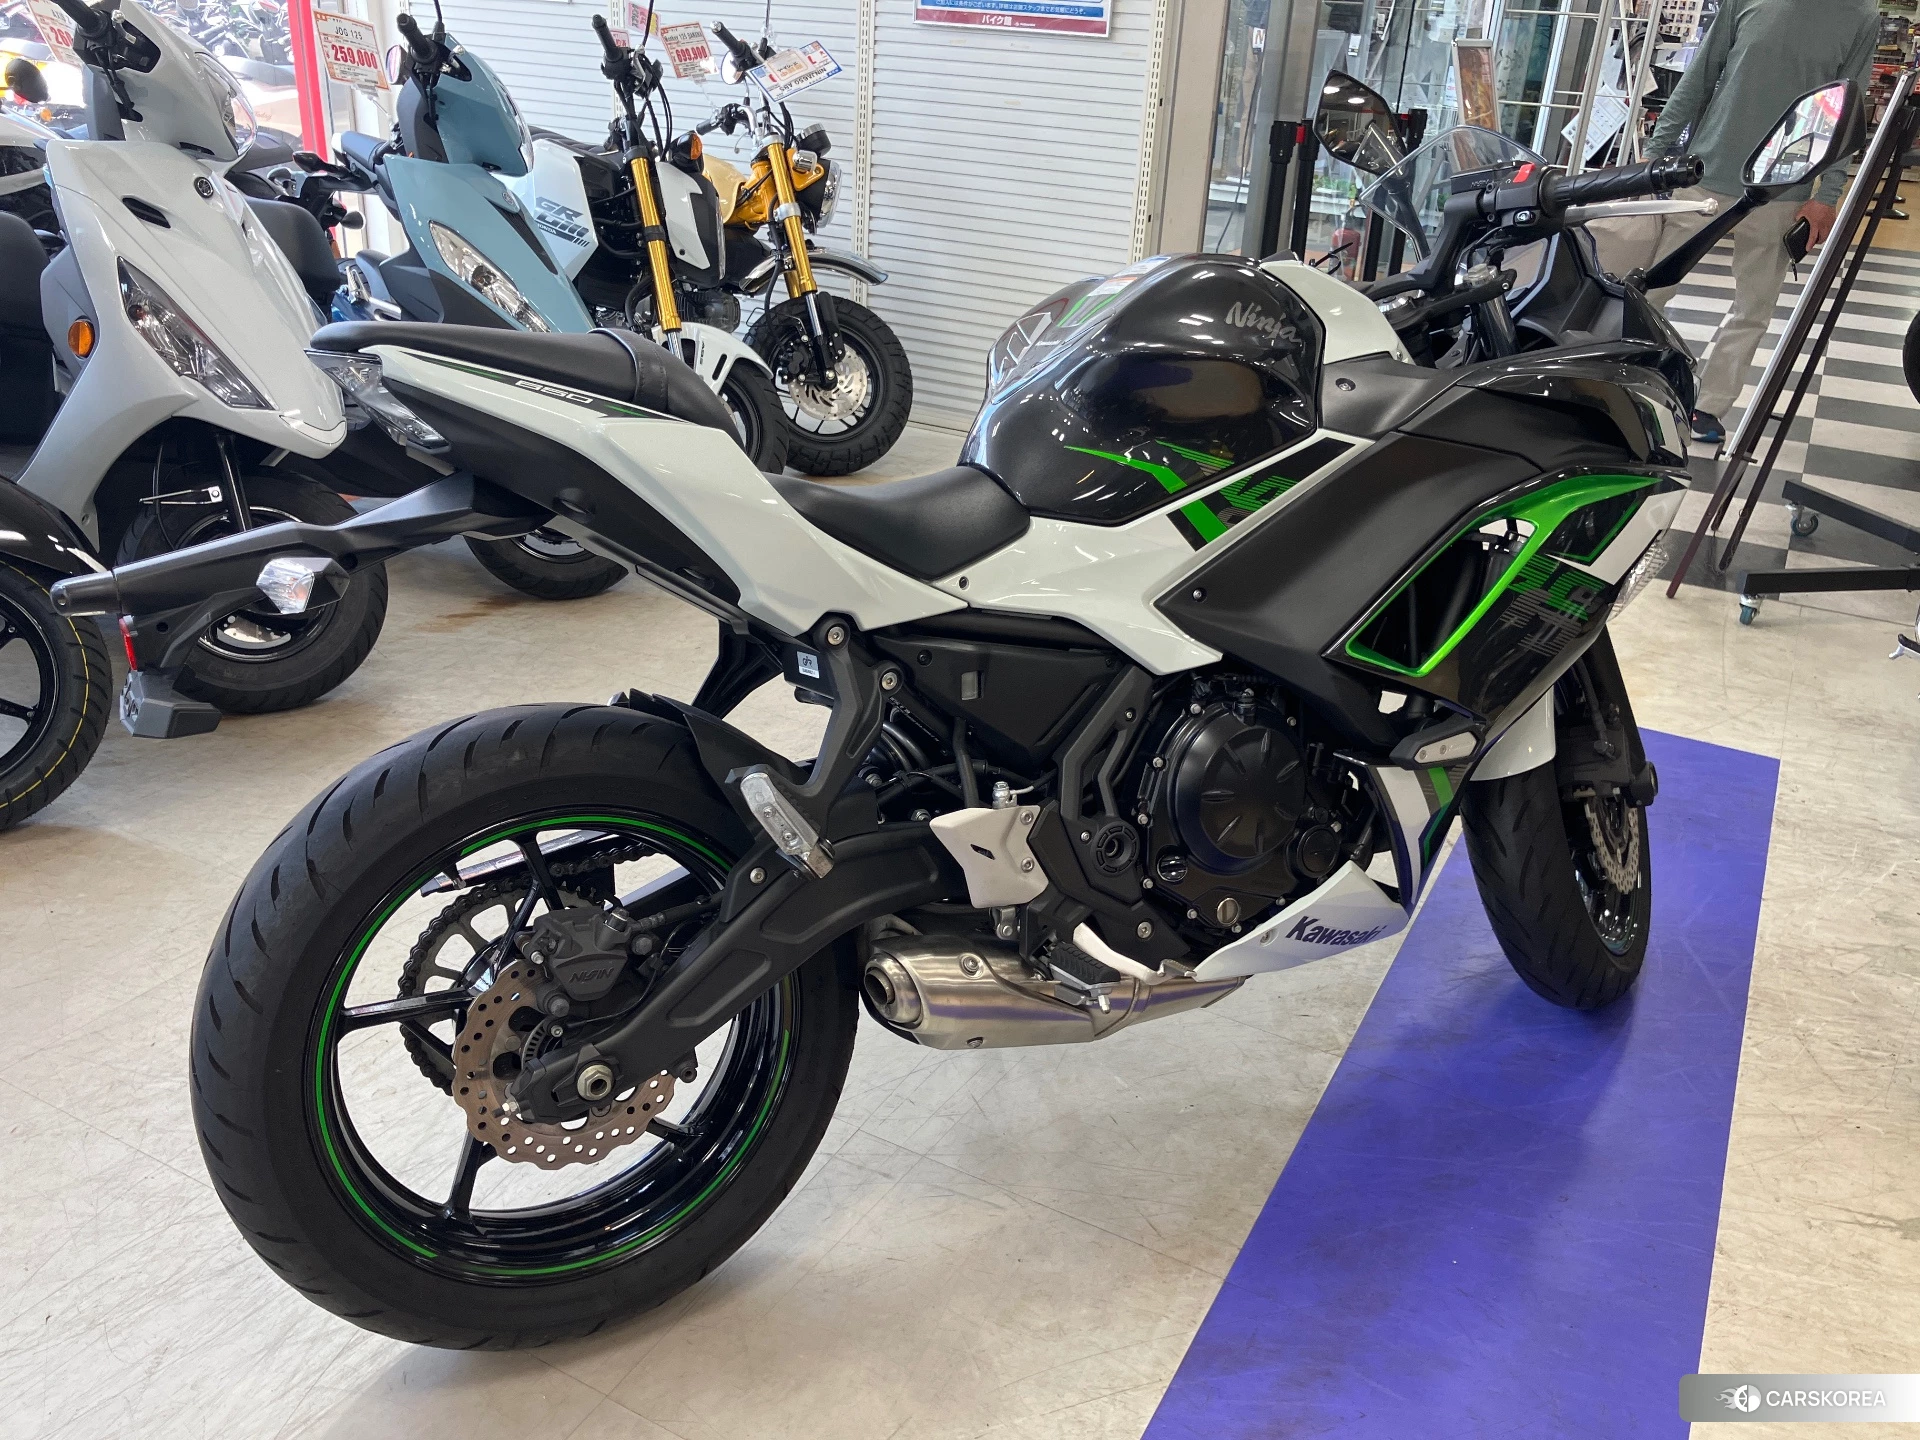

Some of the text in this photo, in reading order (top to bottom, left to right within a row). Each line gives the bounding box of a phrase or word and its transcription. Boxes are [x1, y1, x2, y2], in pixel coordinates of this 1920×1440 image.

[335, 26, 363, 40] JOG 125
[331, 44, 378, 69] 259,000
[675, 45, 708, 62] 699,900
[1224, 301, 1302, 344] Ninja
[515, 379, 594, 404] 650
[1285, 915, 1388, 946] Kawasaki
